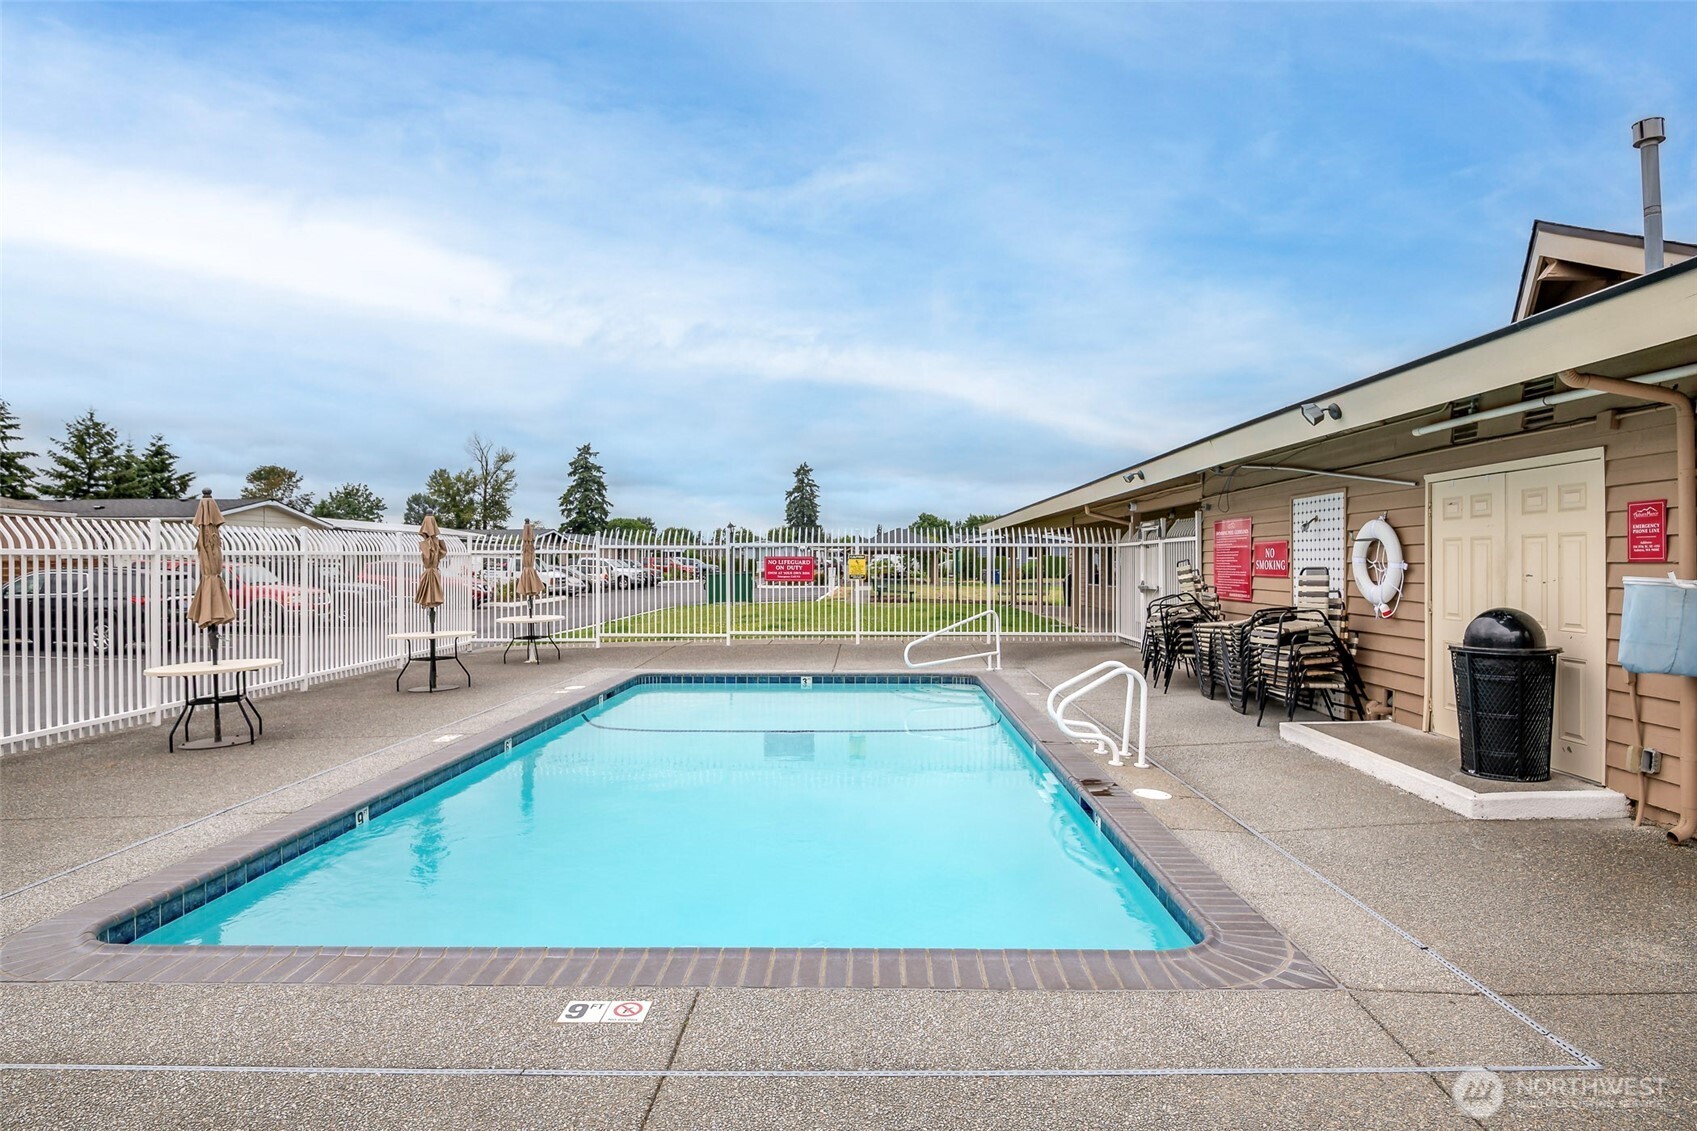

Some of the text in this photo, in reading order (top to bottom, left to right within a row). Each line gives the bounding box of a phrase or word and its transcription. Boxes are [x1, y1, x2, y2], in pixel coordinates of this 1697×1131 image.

[1265, 548, 1275, 558] NO
[1256, 560, 1286, 570] SMOKING
[803, 678, 807, 687] 3
[358, 812, 363, 825] 9
[565, 1004, 589, 1018] 9
